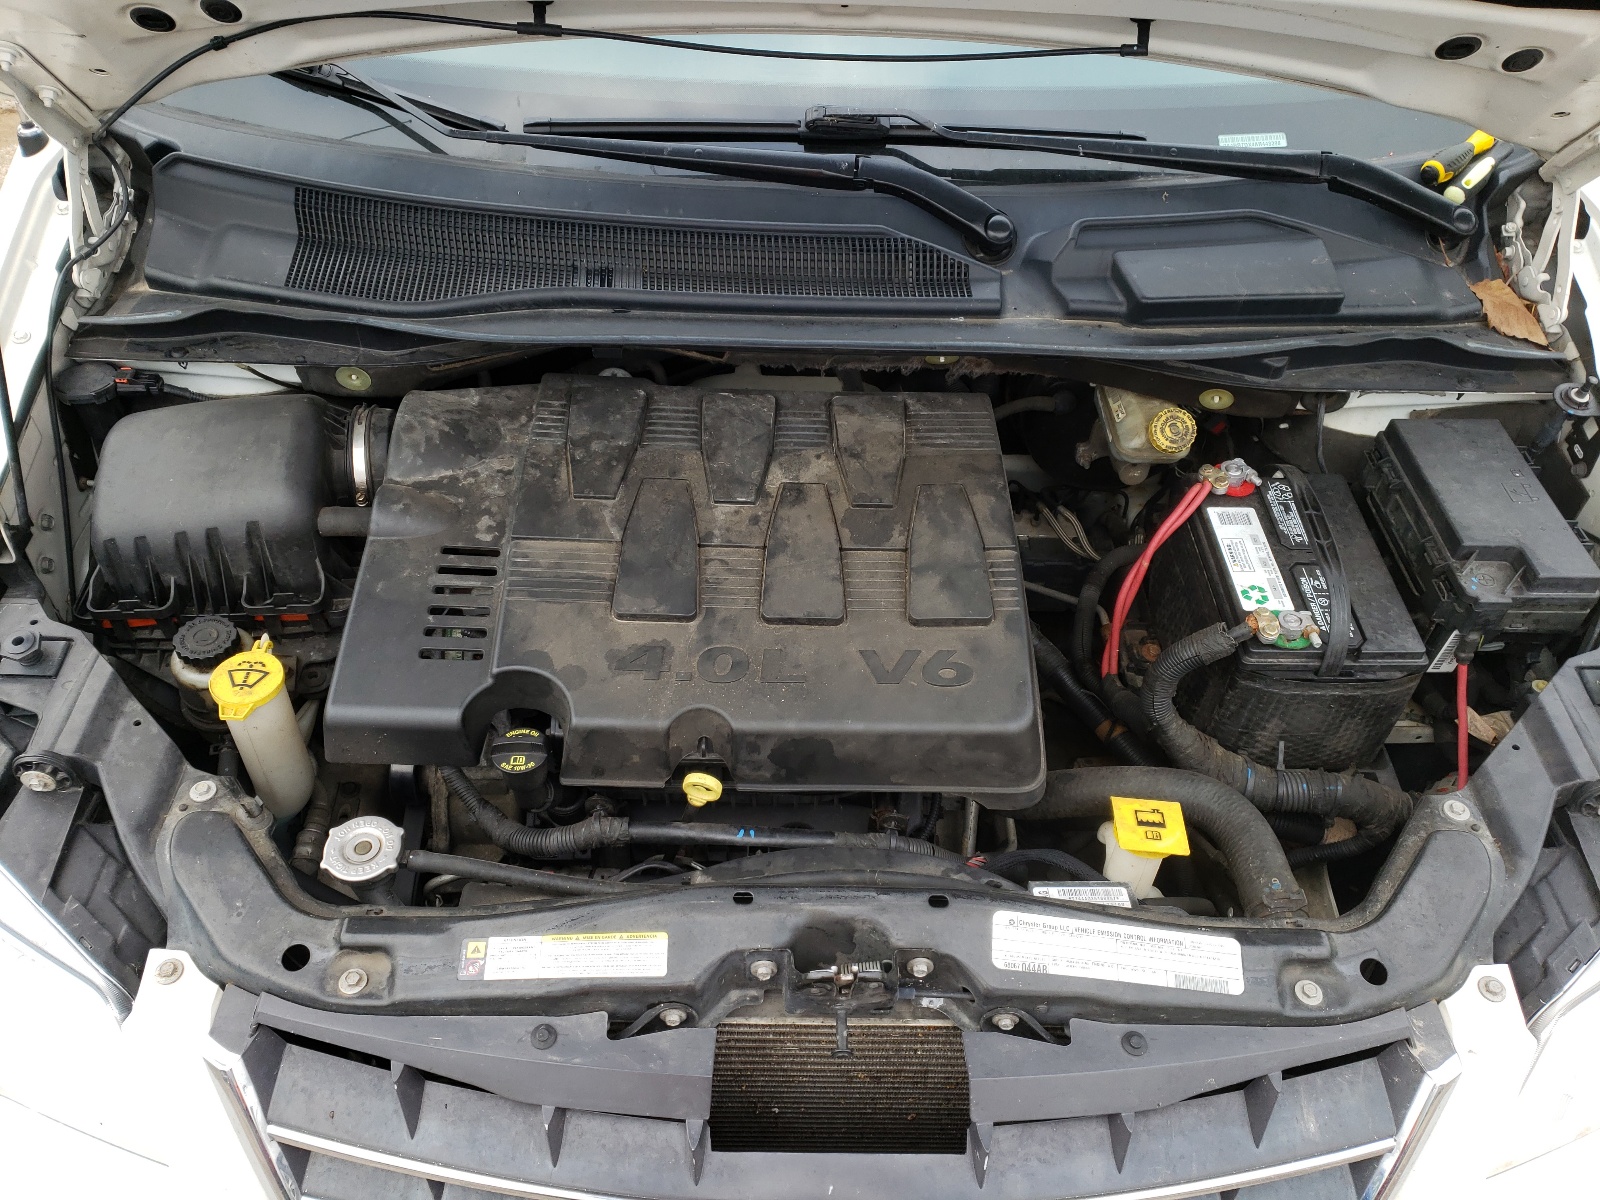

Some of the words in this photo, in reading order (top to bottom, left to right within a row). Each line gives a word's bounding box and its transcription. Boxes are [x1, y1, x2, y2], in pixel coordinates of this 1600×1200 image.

[613, 645, 805, 683] 4.0L
[858, 649, 974, 687] V6
[505, 729, 530, 738] ENGINE
[1018, 919, 1041, 928] Chrysler
[1042, 922, 1058, 931] Group
[1074, 926, 1096, 935] VEHICLE
[1097, 929, 1122, 938] EMISSION
[1123, 932, 1147, 942] CONTROL
[1148, 936, 1184, 947] INFORMATION
